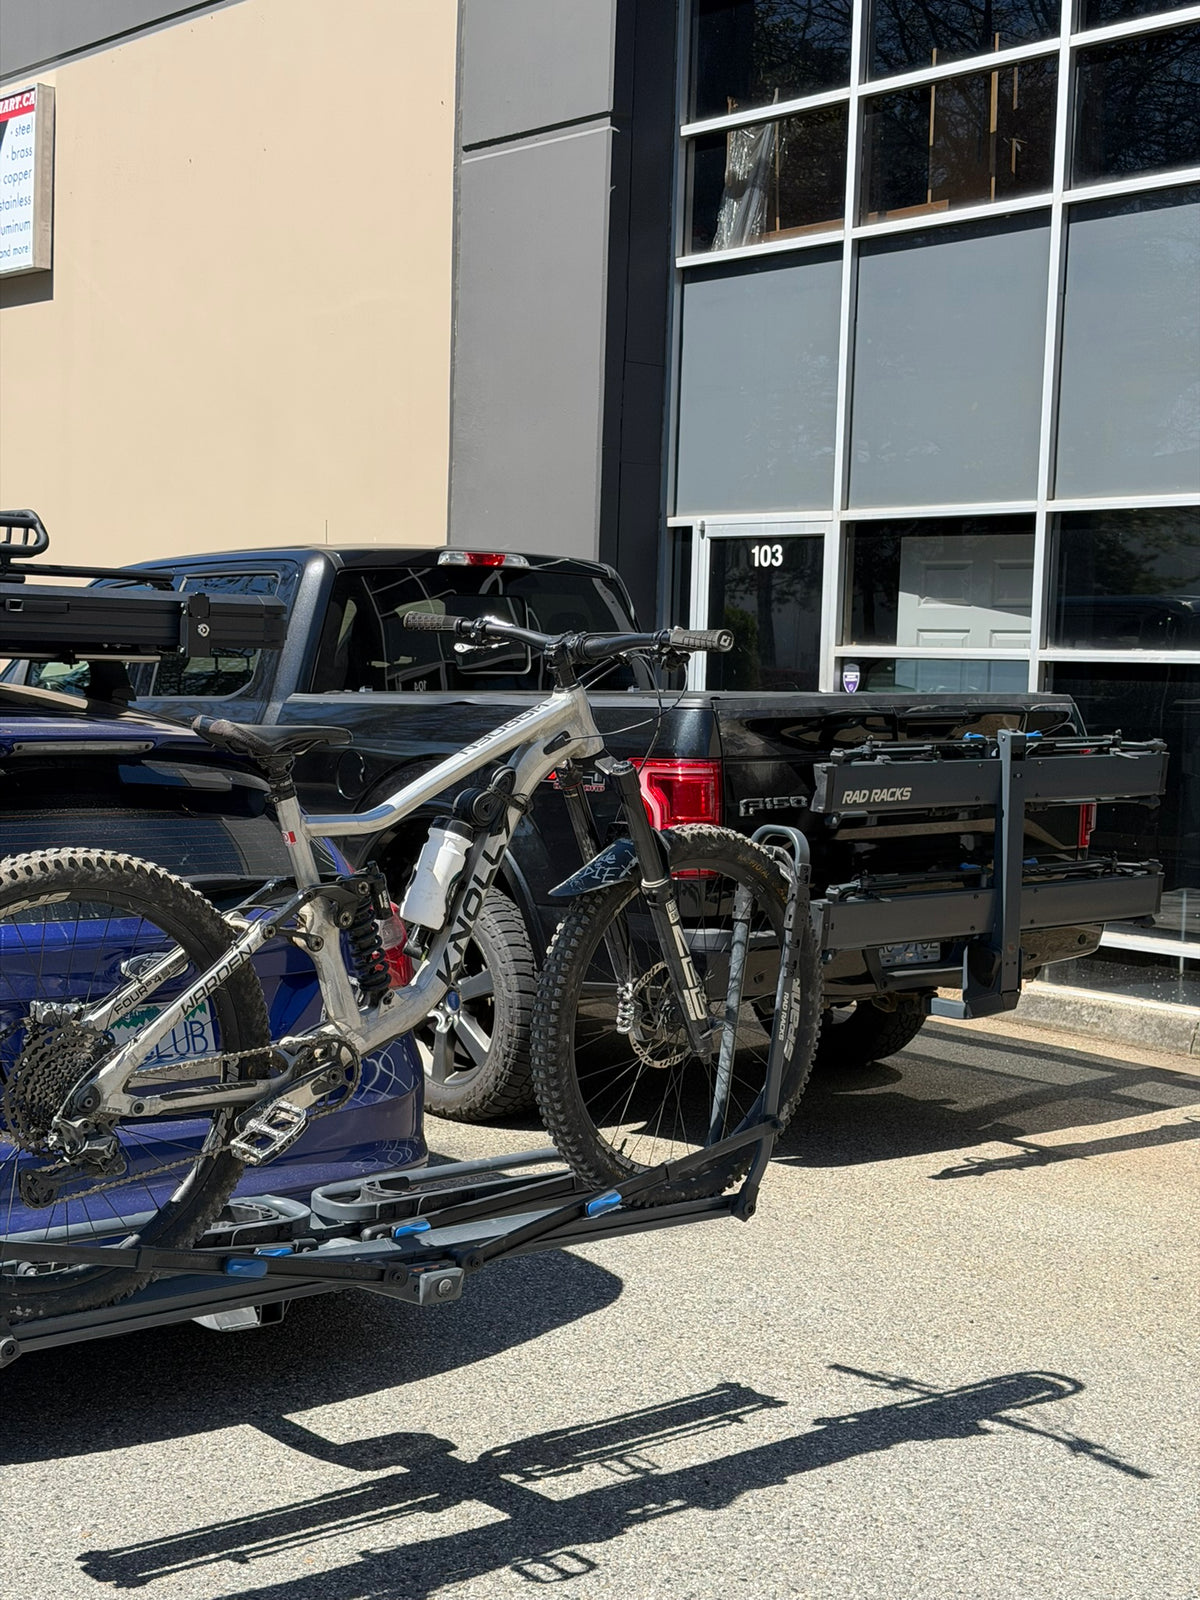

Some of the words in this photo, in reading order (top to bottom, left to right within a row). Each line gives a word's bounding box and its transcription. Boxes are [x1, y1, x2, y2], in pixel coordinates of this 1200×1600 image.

[15, 117, 33, 138] steel
[11, 145, 33, 162] brass
[3, 168, 32, 187] copper
[751, 544, 784, 567] 103
[842, 789, 870, 804] RAD
[870, 787, 912, 803] RACKS
[181, 944, 254, 1014] WARDEN
[113, 985, 149, 1015] FOUR
[782, 991, 790, 1011] RAD
[778, 1011, 788, 1041] RACKS
